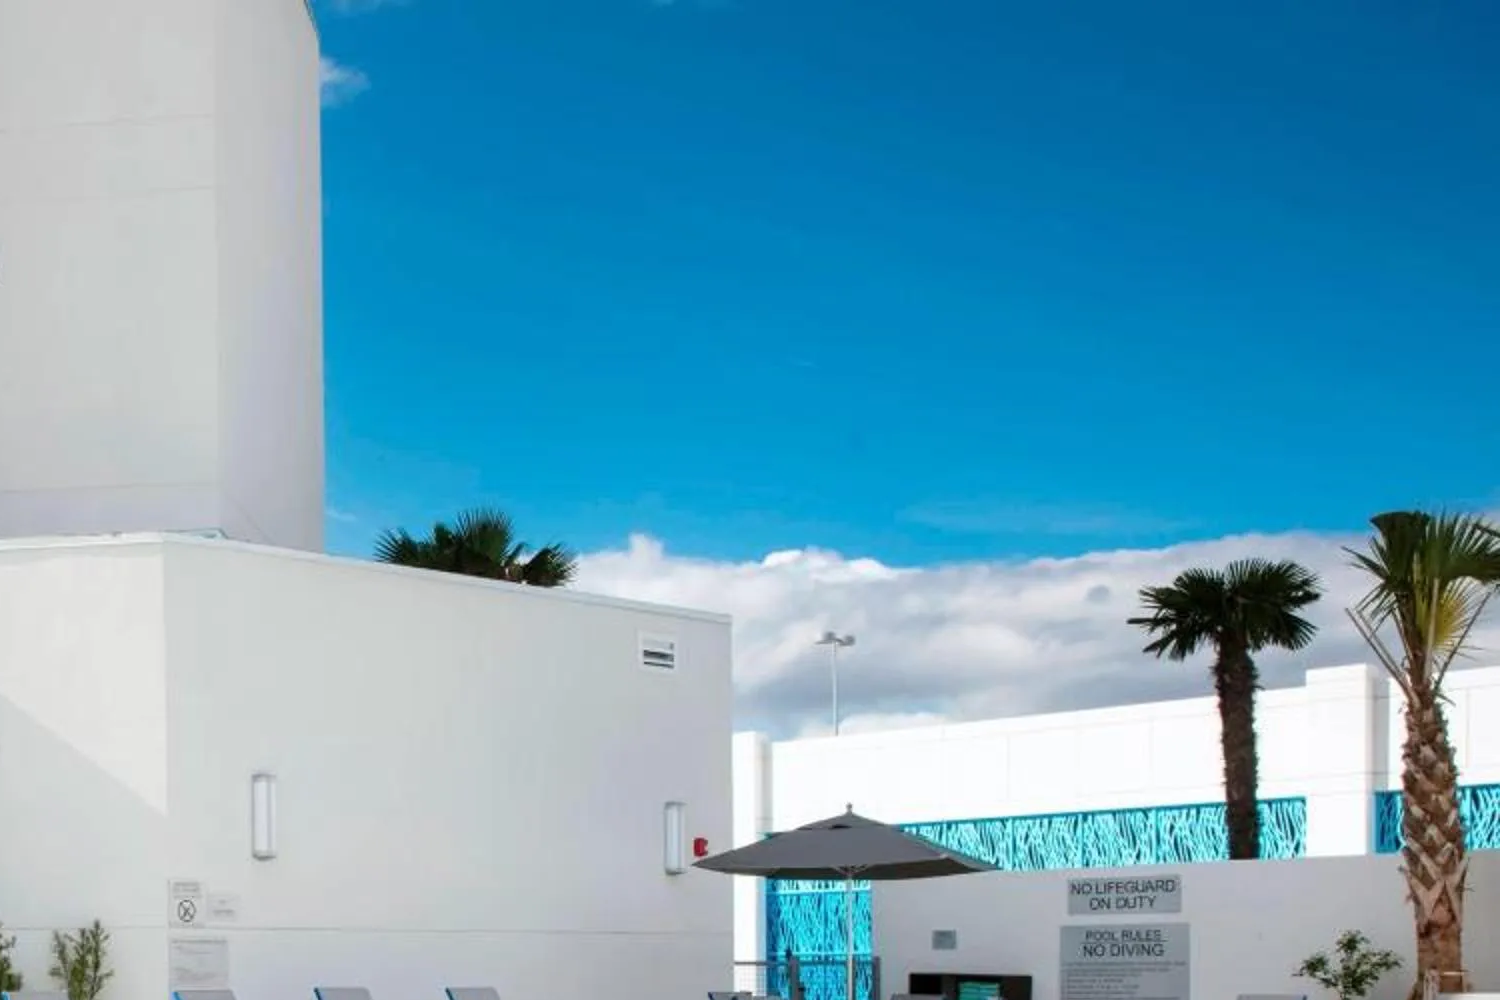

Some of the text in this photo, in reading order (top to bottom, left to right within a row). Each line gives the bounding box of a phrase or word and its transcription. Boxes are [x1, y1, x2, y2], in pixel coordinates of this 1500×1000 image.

[1070, 879, 1175, 895] NO LIFEGUARD
[1089, 895, 1157, 911] ON DUTY
[1085, 929, 1162, 942] POOL RULES
[1083, 943, 1164, 957] NO DIVING
